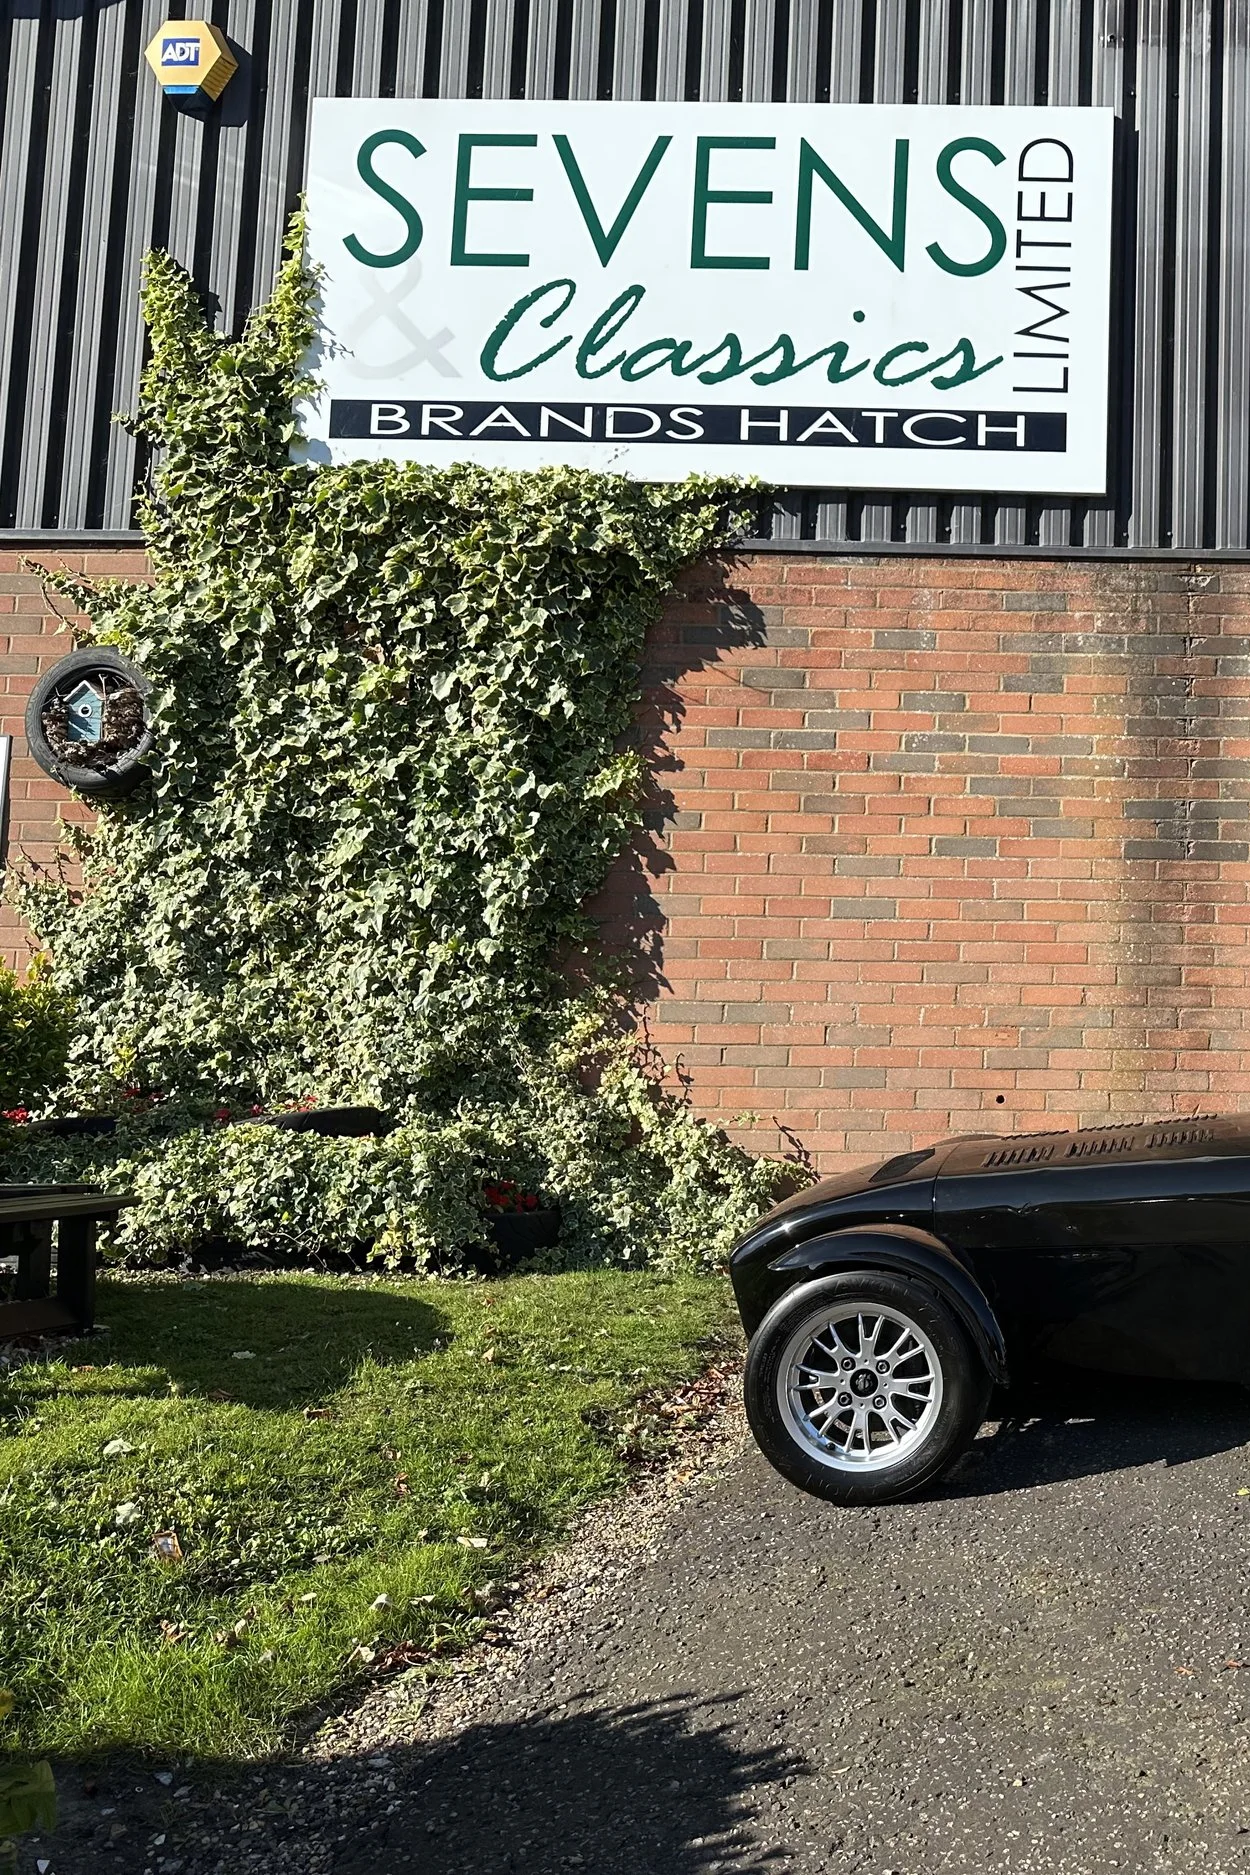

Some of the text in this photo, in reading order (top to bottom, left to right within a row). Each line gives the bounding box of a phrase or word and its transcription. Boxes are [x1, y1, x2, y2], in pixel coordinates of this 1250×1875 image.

[161, 42, 200, 62] ADT
[342, 128, 1007, 278] SEVENS
[1011, 136, 1075, 395] LIMITED
[340, 253, 1004, 391] & Classics
[368, 402, 1027, 448] BRANDS HATCH
